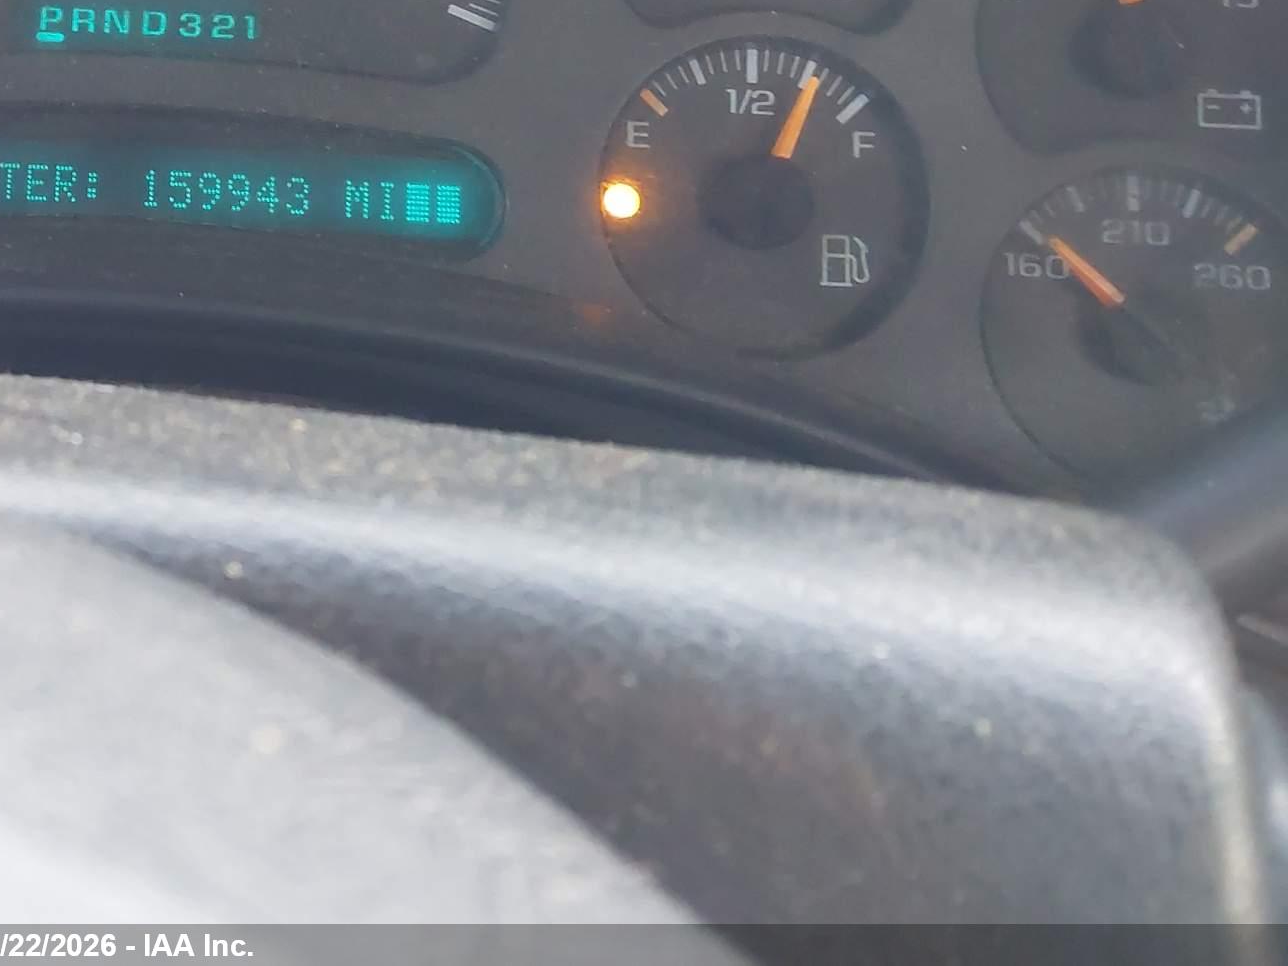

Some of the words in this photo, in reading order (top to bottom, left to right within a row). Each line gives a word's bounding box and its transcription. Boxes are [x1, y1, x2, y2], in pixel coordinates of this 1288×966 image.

[725, 89, 775, 115] 1/2
[626, 121, 650, 148] E
[852, 131, 875, 158] F
[143, 169, 311, 215] 159943
[344, 180, 396, 221] MI
[1101, 219, 1170, 246] 210
[1003, 252, 1070, 280] 160
